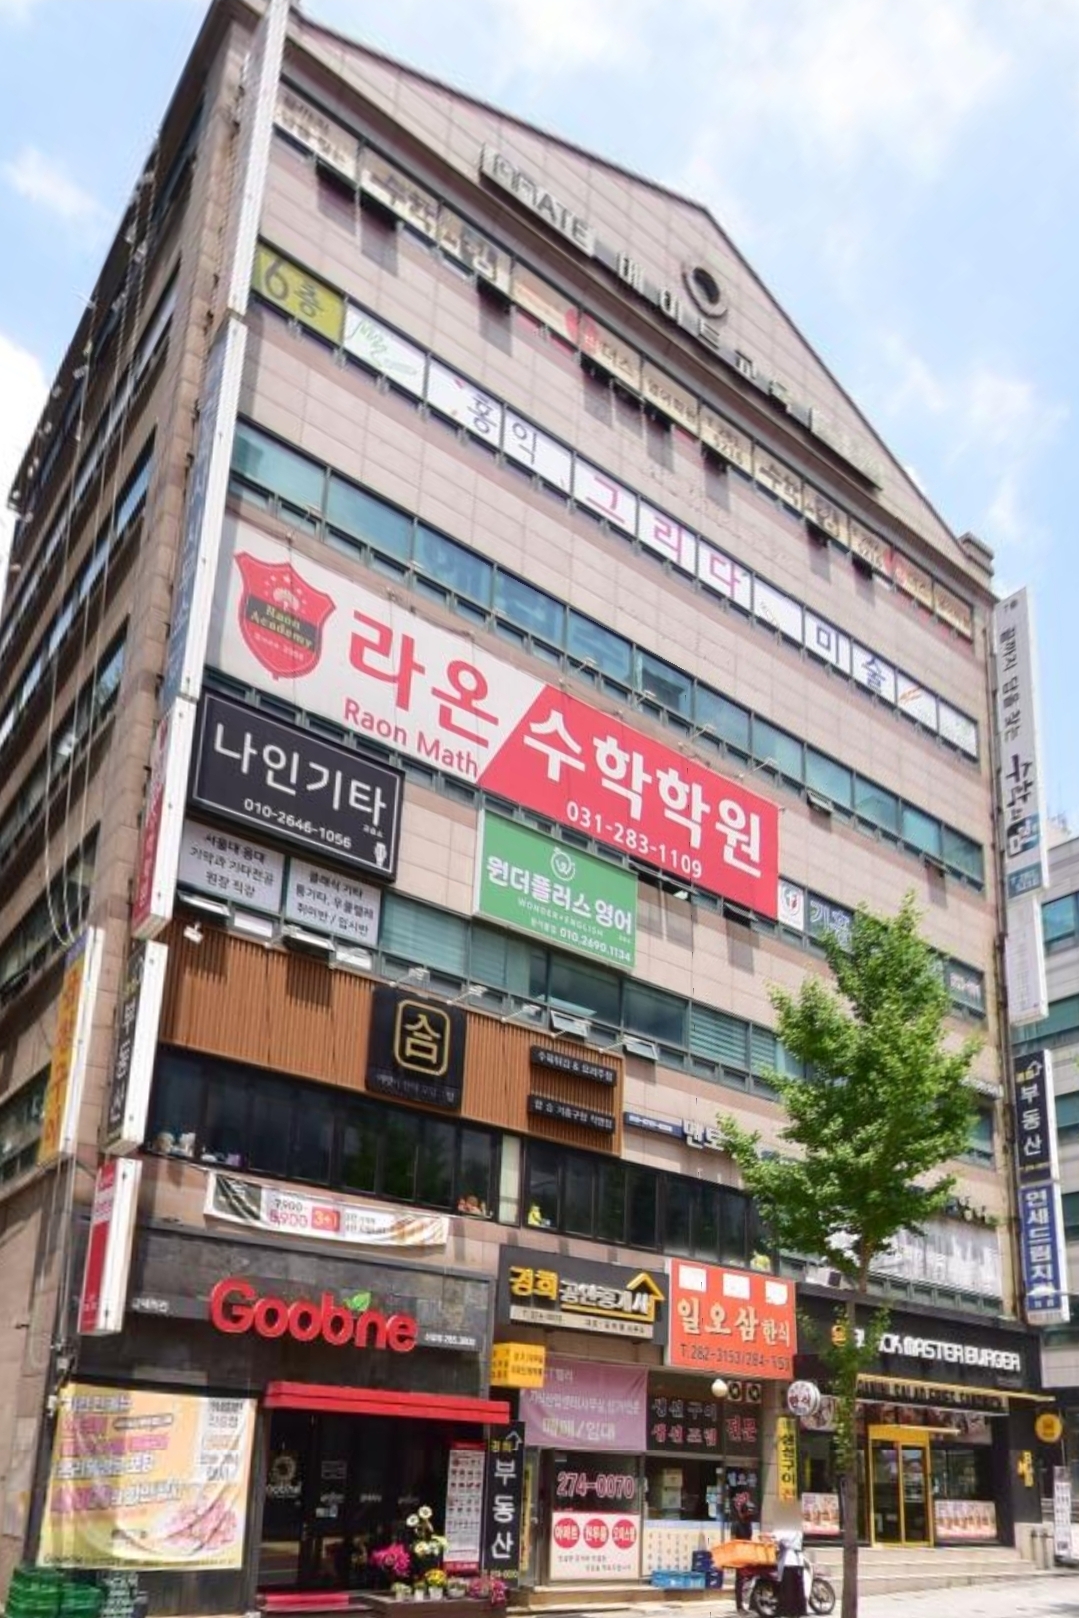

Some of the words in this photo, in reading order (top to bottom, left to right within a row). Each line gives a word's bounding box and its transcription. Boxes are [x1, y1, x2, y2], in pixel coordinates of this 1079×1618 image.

[264, 256, 322, 318] 6층
[466, 393, 538, 465] 홍익
[586, 475, 741, 600] 그리다
[816, 626, 887, 696] 미술
[251, 610, 314, 650] Academy
[214, 723, 387, 826] 나인기타
[344, 699, 408, 746] Raon
[417, 732, 479, 779] Math
[350, 610, 499, 748] 라온
[524, 709, 761, 878] 수학학원
[244, 798, 352, 849] 010-2646-1056
[566, 801, 703, 879] 031-283-1109
[206, 871, 231, 889] 원장
[487, 855, 592, 918] 원더플러스
[594, 899, 632, 936] 영어
[1020, 1083, 1042, 1156] 부동산
[210, 1276, 418, 1352] Goobne
[509, 1265, 558, 1301] 경희
[677, 1296, 758, 1343] 일오삼
[761, 1318, 791, 1348] 한식
[903, 1335, 963, 1364] MASTER
[963, 1343, 1022, 1372] BURGER
[489, 1459, 518, 1560] 부동산
[556, 1471, 635, 1500] 274-0070
